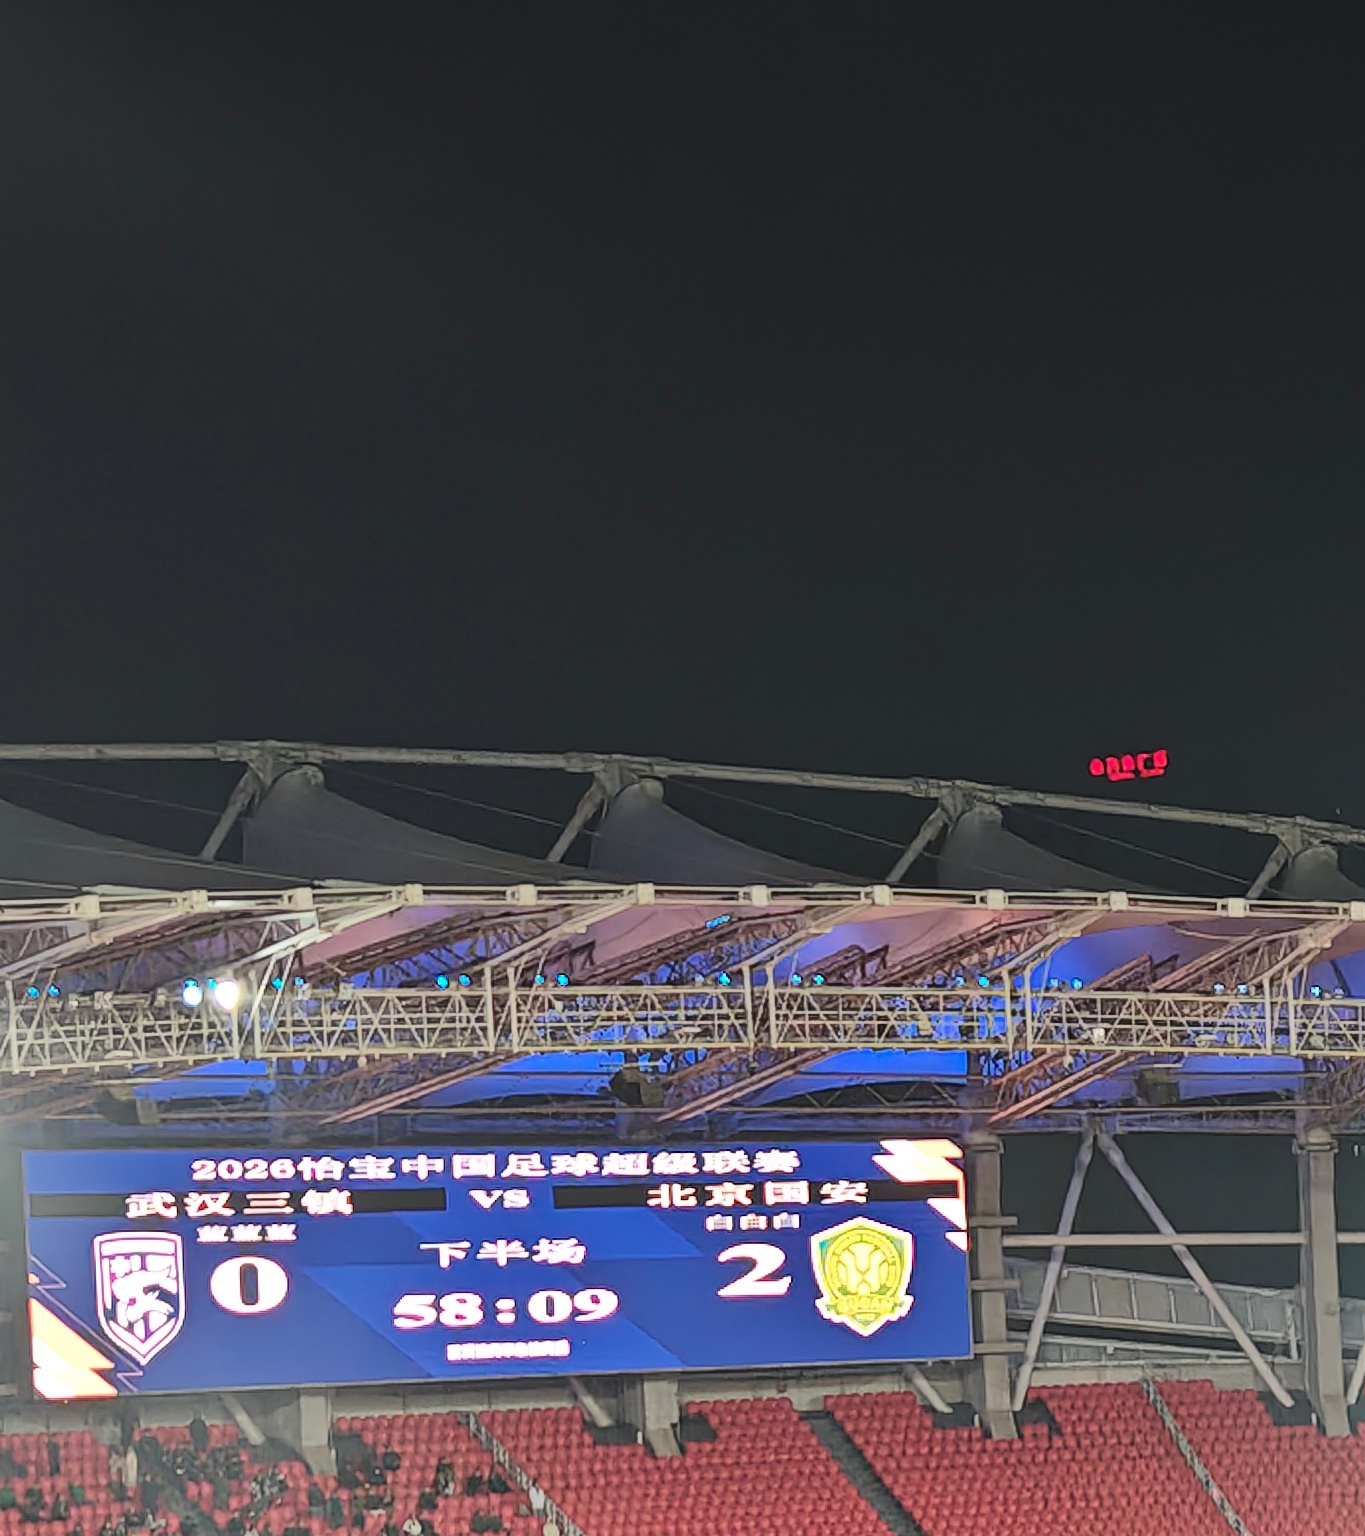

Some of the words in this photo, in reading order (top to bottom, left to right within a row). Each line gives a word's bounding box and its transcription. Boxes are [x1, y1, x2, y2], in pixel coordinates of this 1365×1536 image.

[190, 1149, 802, 1182] 2026怡宝中国足球超级联赛
[125, 1190, 355, 1219] 武汉三镇
[468, 1188, 530, 1209] VS
[646, 1179, 870, 1208] 北京国安
[418, 1237, 588, 1269] 下半场
[209, 1255, 290, 1316] 0
[716, 1242, 793, 1299] 2
[392, 1286, 620, 1330] 58:09
